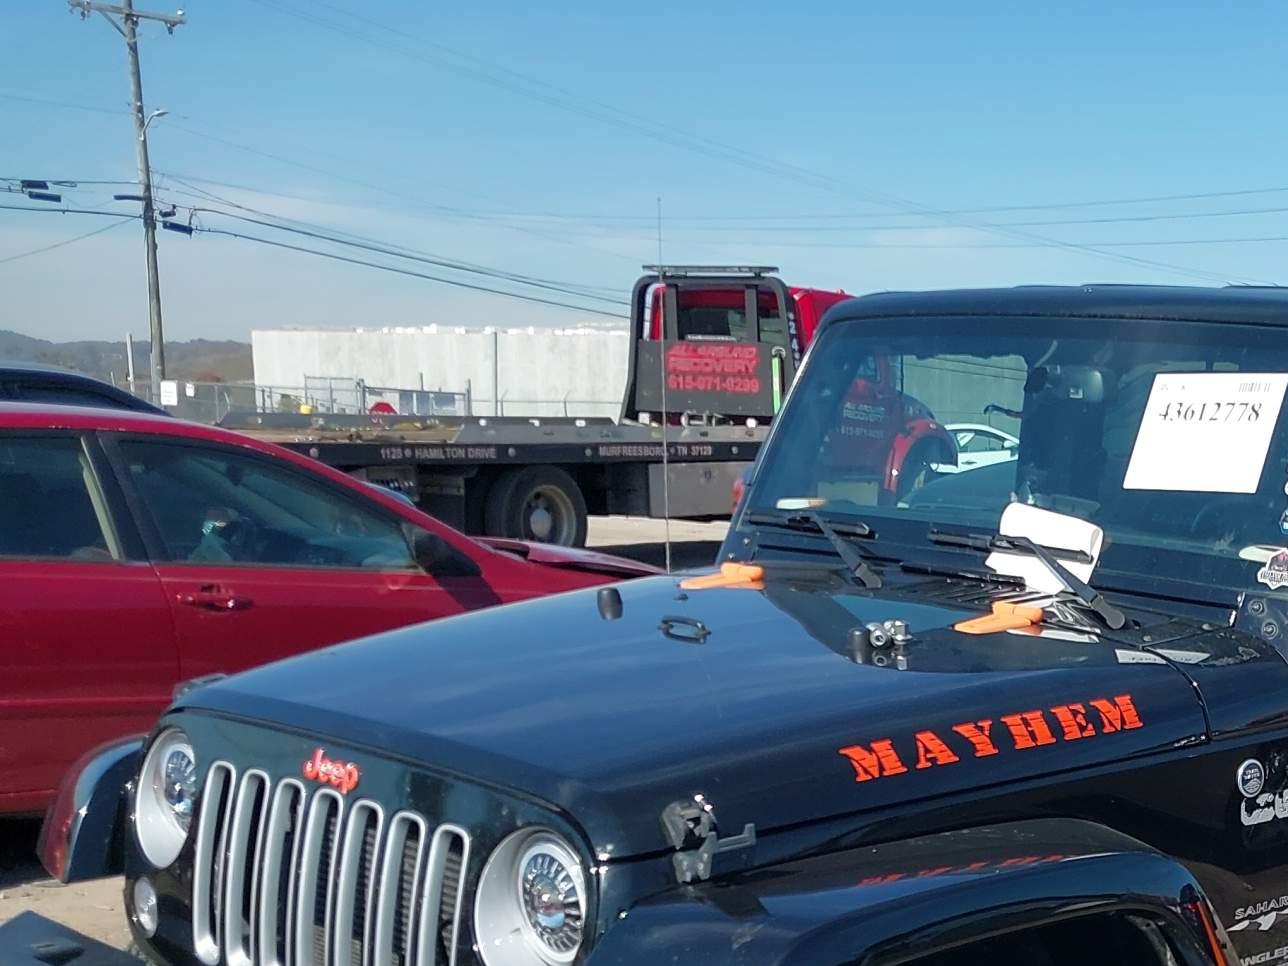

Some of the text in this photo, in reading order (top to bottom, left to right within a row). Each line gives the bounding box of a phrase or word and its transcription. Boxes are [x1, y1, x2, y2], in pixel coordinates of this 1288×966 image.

[667, 357, 758, 373] RECOVERY
[1159, 402, 1263, 422] 43612778
[415, 447, 466, 460] HAMILTON
[467, 447, 497, 460] DRIVE
[677, 446, 688, 457] TN
[838, 692, 1144, 783] MAYHEM
[303, 747, 360, 796] Jeep
